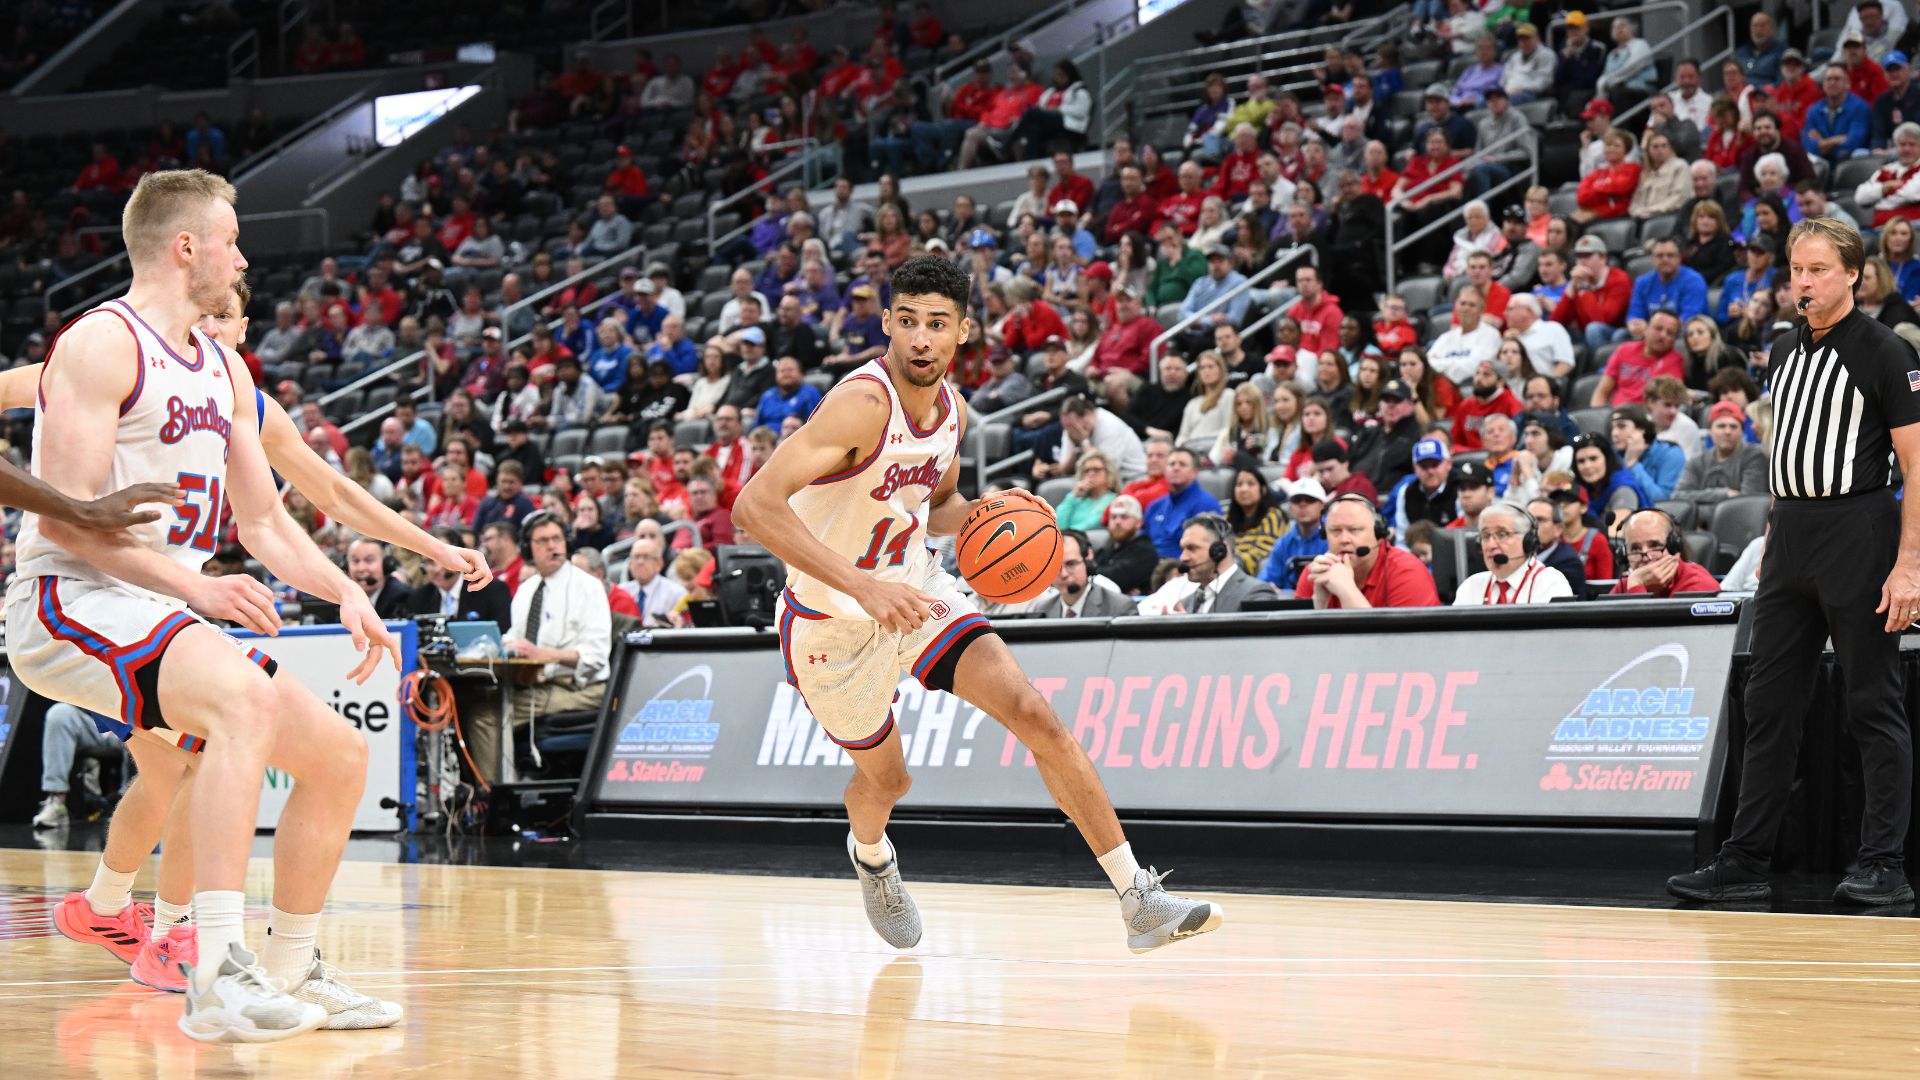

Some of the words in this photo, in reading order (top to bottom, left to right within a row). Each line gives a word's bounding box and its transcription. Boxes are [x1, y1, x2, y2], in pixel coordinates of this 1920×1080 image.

[160, 395, 232, 465] Bradley
[870, 455, 942, 504] Bradley
[167, 472, 220, 553] 51
[959, 499, 1006, 538] ELITE
[855, 512, 919, 571] 14
[1000, 561, 1030, 585] VALLEY
[326, 690, 389, 732] ise
[638, 700, 714, 722] ARCH
[1072, 672, 1291, 770] BEGINS
[1298, 671, 1479, 769] HERE.
[1580, 686, 1695, 716] ARCH
[618, 723, 721, 742] MADNESS
[756, 678, 987, 767] MACH?
[1553, 717, 1710, 741] MADNESS
